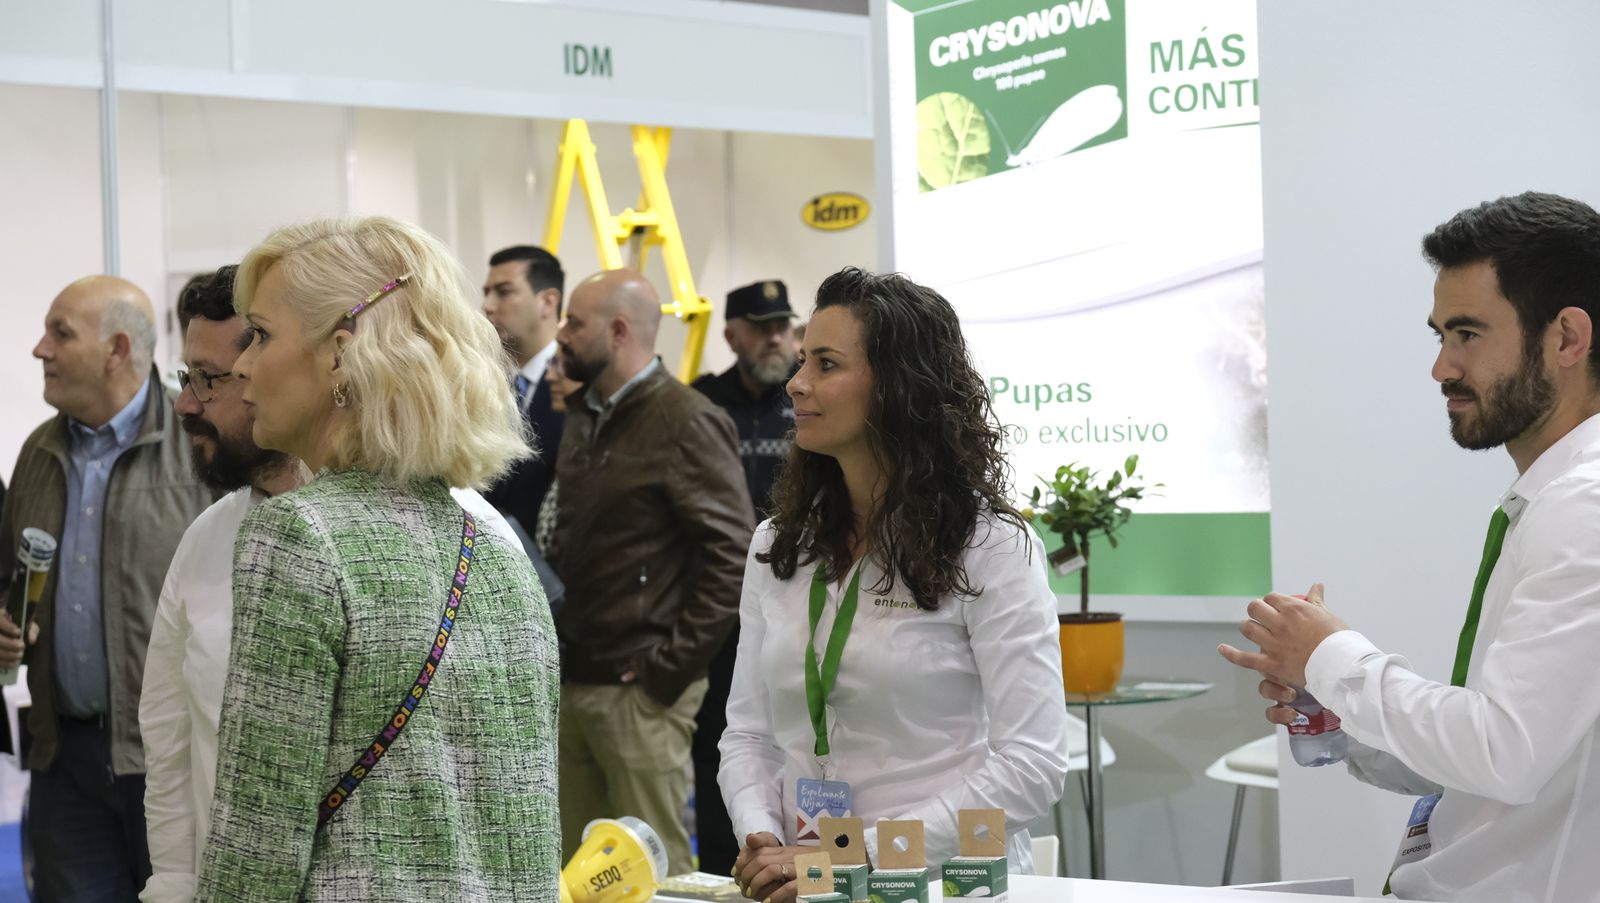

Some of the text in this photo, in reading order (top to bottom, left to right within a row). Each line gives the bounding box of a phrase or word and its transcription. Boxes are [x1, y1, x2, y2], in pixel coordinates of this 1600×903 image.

[929, 0, 1111, 67] CRYSONOVA
[1149, 26, 1246, 74] MÁS
[563, 44, 613, 77] IDM
[811, 196, 861, 223] idm
[990, 376, 1092, 410] Pupas
[1038, 416, 1168, 444] exclusivo
[455, 520, 475, 585] FASHION
[431, 586, 463, 667] FASHION
[383, 661, 435, 741] FASHION
[590, 865, 624, 892] SEDQ
[871, 881, 916, 889] CRYSONOVA
